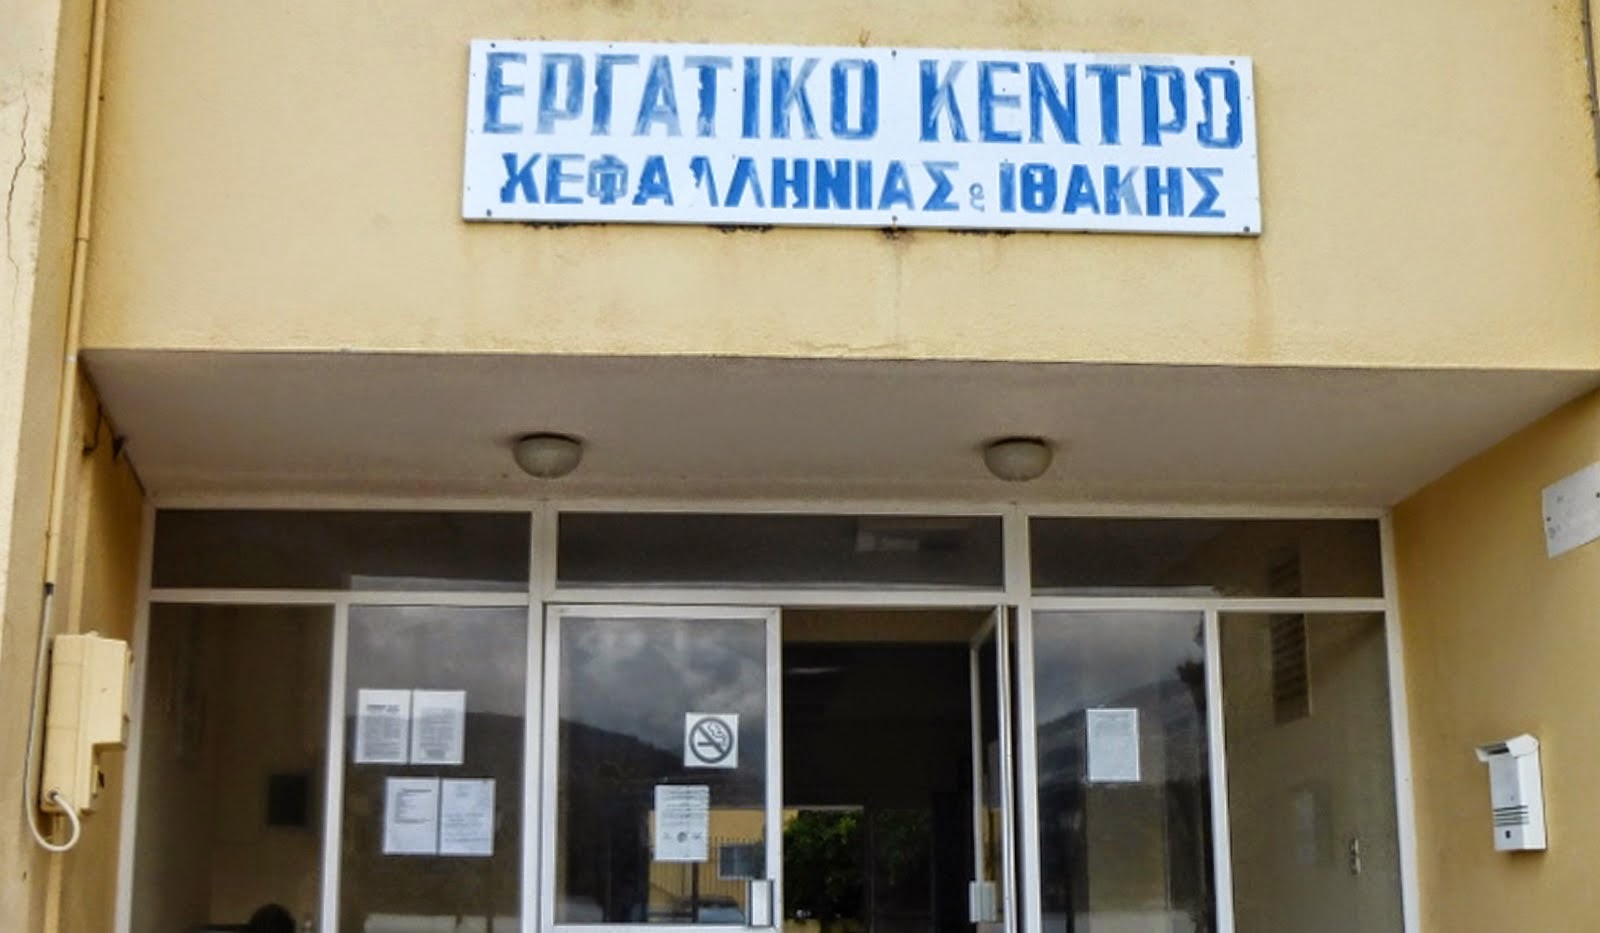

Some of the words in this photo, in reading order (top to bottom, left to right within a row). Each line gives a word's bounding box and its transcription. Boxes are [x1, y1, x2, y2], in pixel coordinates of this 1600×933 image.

[482, 50, 880, 142] ΕΡΓΑΤΙΚΟ
[918, 58, 1243, 150] ΚΕΝΤΡΟ
[999, 160, 1227, 220] ΙΘΑΚΗΣ
